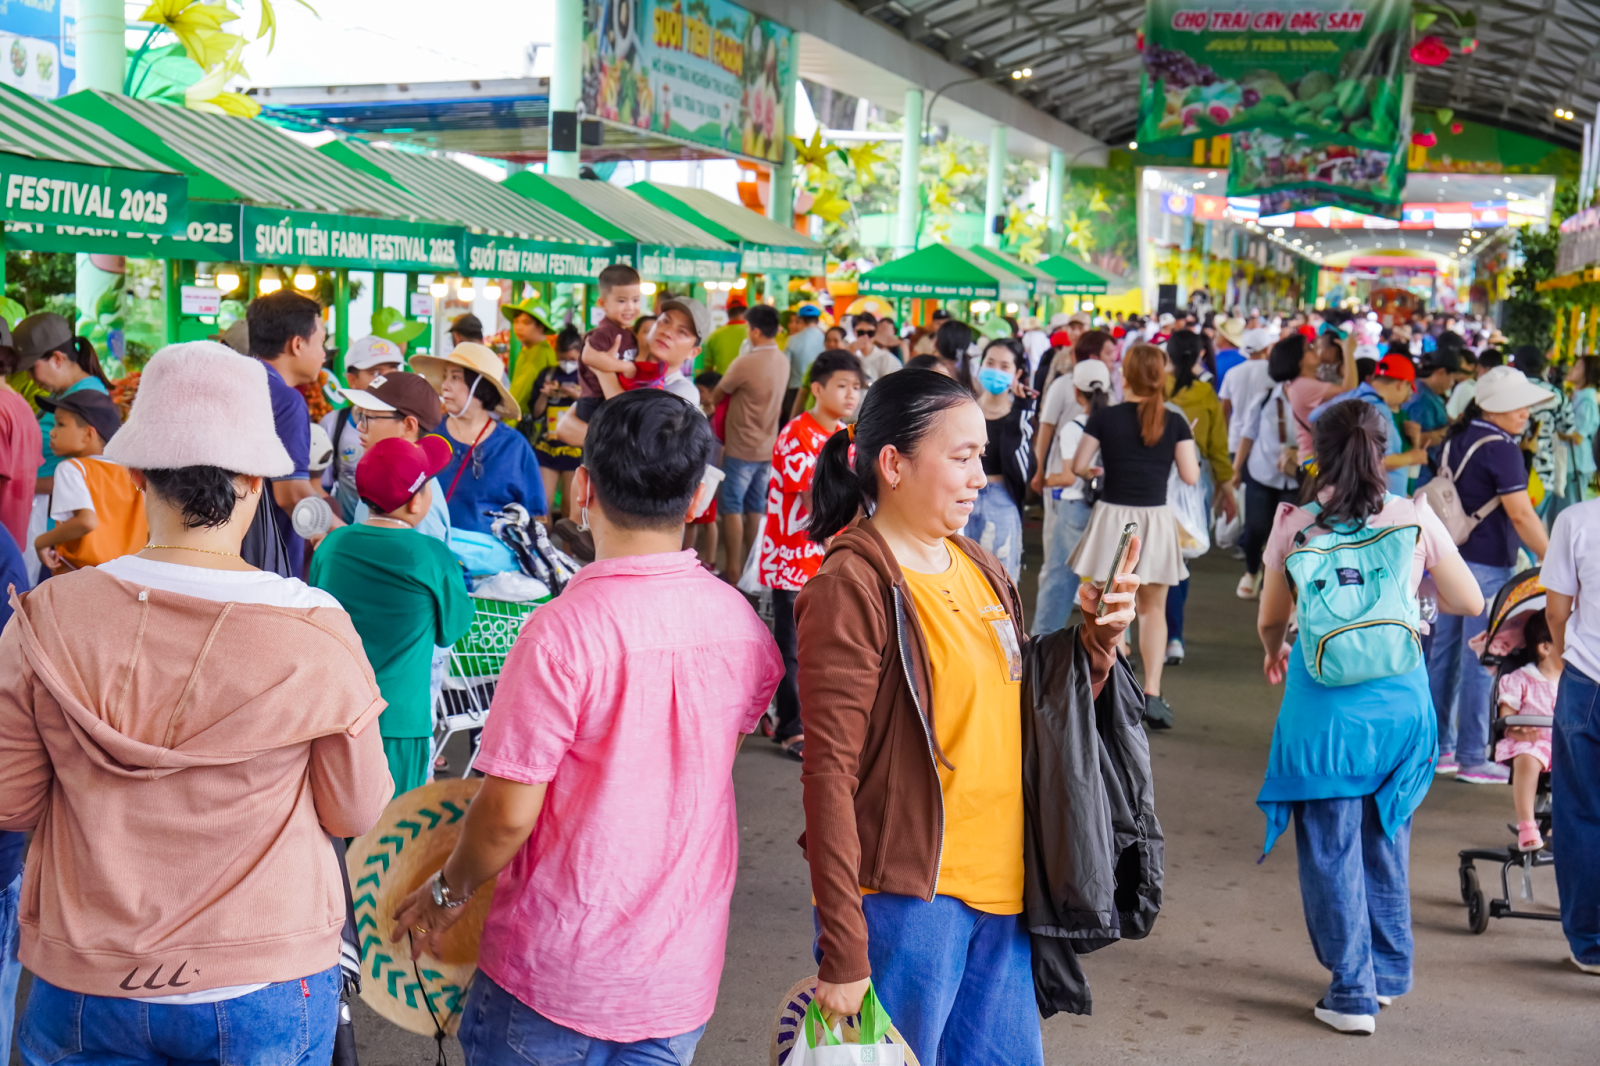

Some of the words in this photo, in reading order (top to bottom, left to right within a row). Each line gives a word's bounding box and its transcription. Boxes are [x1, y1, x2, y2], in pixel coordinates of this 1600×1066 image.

[6, 173, 115, 219] FESTIVAL
[119, 187, 168, 225] 2025
[172, 221, 234, 244] 025
[255, 216, 293, 255] SUỐI
[295, 221, 329, 257] TIÊN
[331, 230, 369, 259] FARM
[370, 233, 428, 264] FESTIVAL
[429, 238, 456, 264] 2025
[469, 240, 496, 271] SUỐI
[497, 244, 521, 272] TIÊN
[521, 251, 548, 274] FARM
[549, 253, 589, 277] FESTIVAL
[467, 634, 518, 649] FOOD
[469, 619, 519, 635] COOP
